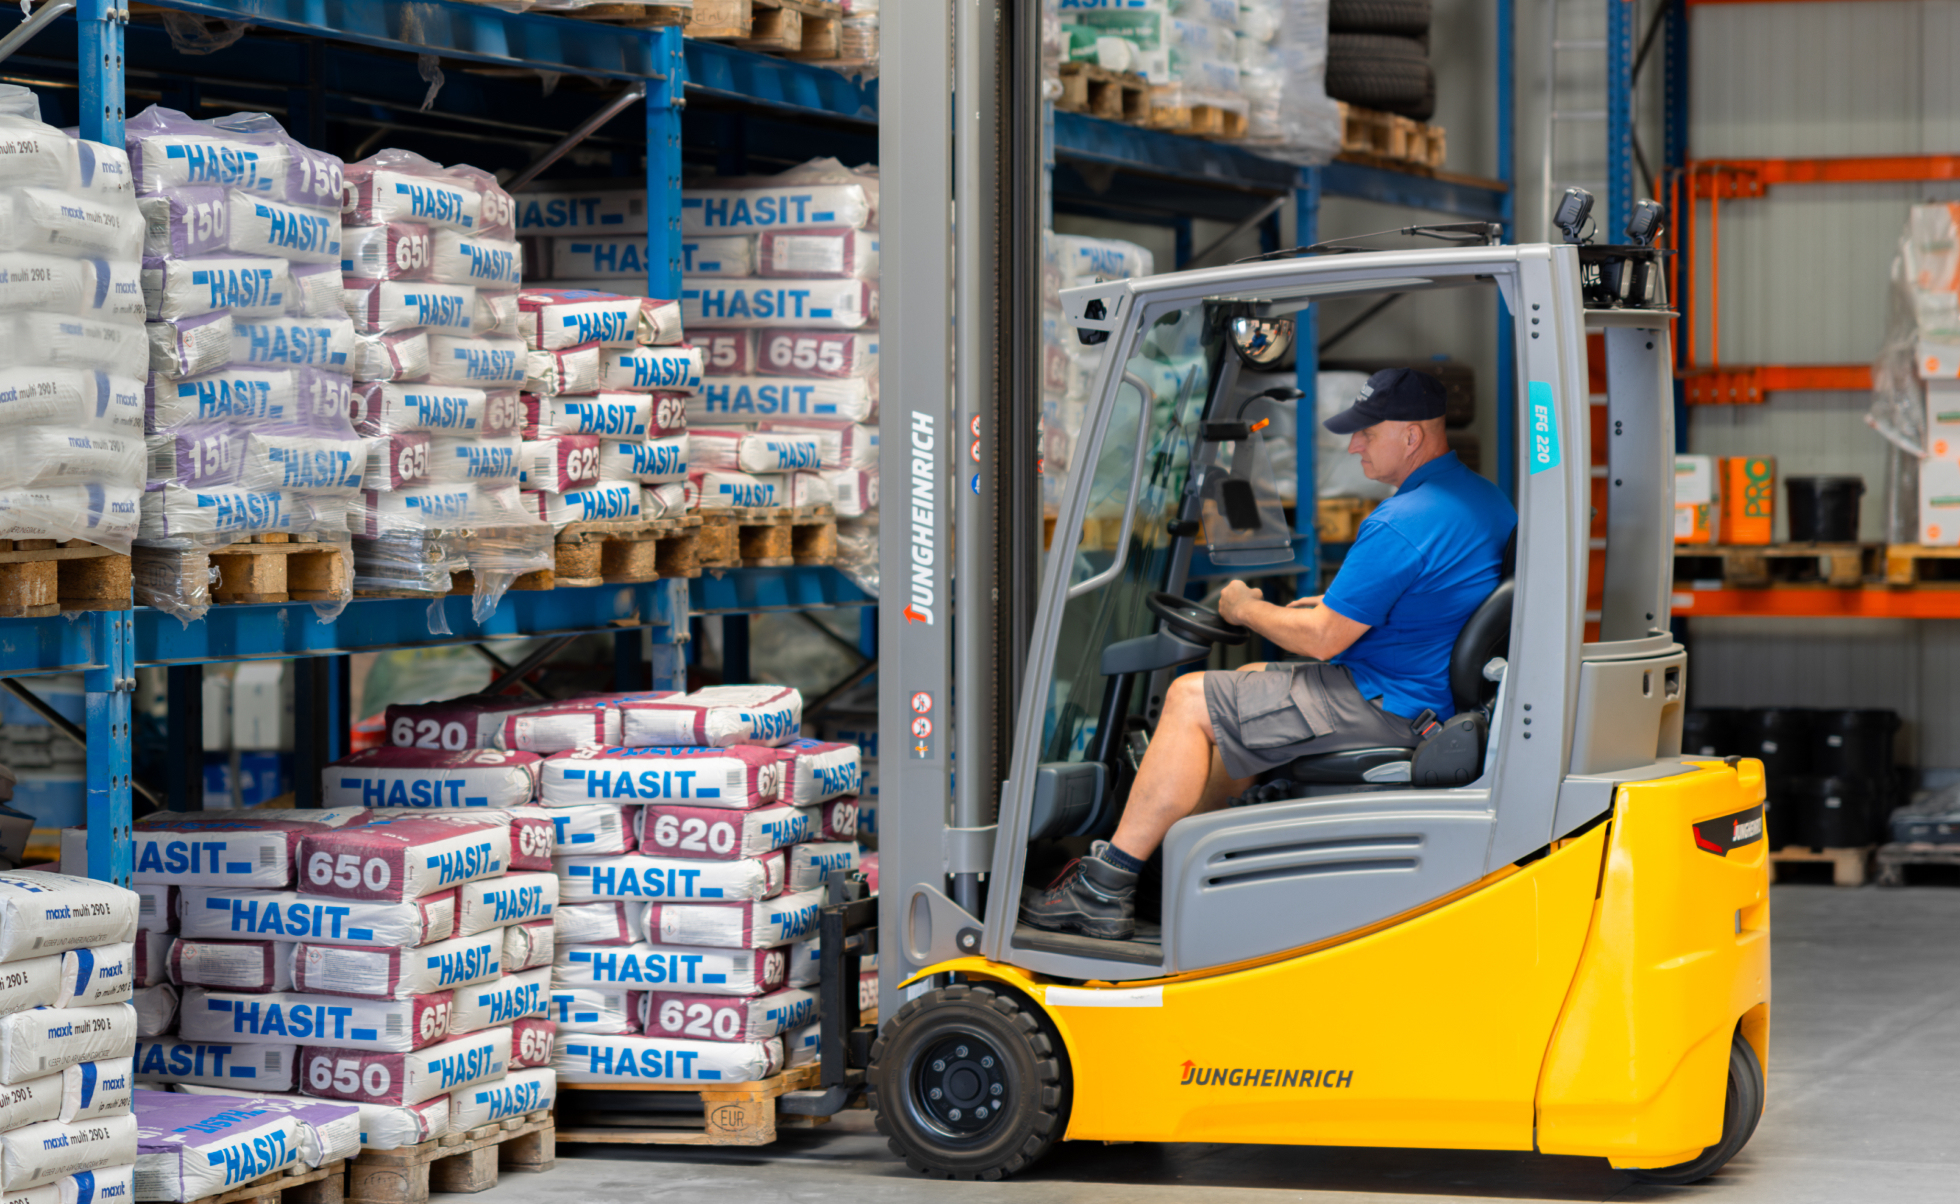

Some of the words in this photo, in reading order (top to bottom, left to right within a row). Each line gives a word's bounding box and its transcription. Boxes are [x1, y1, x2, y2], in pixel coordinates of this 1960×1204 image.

[17, 141, 34, 154] 290
[34, 141, 40, 153] E
[184, 145, 259, 188] HASIT
[299, 156, 343, 200] 150
[61, 205, 85, 221] maxit
[86, 211, 103, 224] multi
[409, 184, 464, 224] HASIT
[704, 194, 812, 227] HASIT
[181, 200, 225, 246] 150
[268, 207, 331, 253] HASIT
[395, 234, 430, 271] 650
[469, 245, 514, 281] HASIT
[10, 269, 29, 283] multi
[31, 268, 46, 283] 290
[115, 280, 137, 294] maxit
[209, 269, 273, 309] HASIT
[417, 294, 464, 328] HASIT
[702, 289, 811, 319] HASIT
[249, 324, 331, 364] HASIT
[577, 311, 628, 344] HASIT
[466, 348, 516, 381] HASIT
[633, 356, 691, 388] HASIT
[769, 337, 845, 373] 655
[0, 386, 18, 403] axit
[19, 383, 38, 399] multi
[38, 382, 51, 397] 290
[116, 393, 138, 408] maxit
[196, 379, 271, 419] HASIT
[309, 377, 351, 419] 150
[705, 385, 815, 415] HASIT
[417, 395, 469, 429] HASIT
[579, 403, 637, 435] HASIT
[1535, 404, 1549, 432] EFG
[68, 436, 92, 450] maxit
[188, 433, 231, 480] 150
[632, 444, 680, 475] HASIT
[777, 442, 816, 470] HASIT
[1536, 434, 1550, 464] 220
[282, 449, 352, 488] HASIT
[466, 446, 513, 478] HASIT
[580, 487, 631, 521] HASIT
[732, 484, 775, 508] HASIT
[1744, 459, 1772, 517] PRO
[112, 500, 135, 513] maxit
[215, 491, 283, 531] HASIT
[911, 411, 935, 625] JUNGHEINRICH
[391, 716, 468, 751] 620
[749, 708, 793, 741] HASIT
[362, 778, 466, 808] HASIT
[587, 769, 697, 798] HASIT
[757, 764, 778, 798] 62
[821, 762, 857, 796] HASIT
[653, 814, 737, 855] 620
[771, 814, 809, 850] HASIT
[307, 851, 391, 892] 650
[438, 843, 492, 886] HASIT
[592, 866, 701, 898] HASIT
[46, 905, 71, 920] maxit
[72, 904, 91, 918] multi
[90, 903, 106, 916] 290
[106, 903, 111, 915] E
[231, 898, 351, 938] HASIT
[493, 885, 543, 922] HASIT
[780, 903, 818, 941] HASIT
[6, 973, 22, 988] 290
[22, 971, 28, 984] E
[99, 960, 123, 979] maxit
[439, 944, 492, 986] HASIT
[592, 951, 703, 984] HASIT
[763, 951, 784, 984] 62
[234, 1000, 353, 1039] HASIT
[488, 982, 541, 1024] HASIT
[659, 999, 741, 1040] 620
[775, 998, 814, 1036] HASIT
[48, 1022, 73, 1039] maxit
[74, 1019, 91, 1034] multi
[92, 1018, 108, 1032] 290
[519, 1027, 554, 1065] 650
[590, 1045, 698, 1080] HASIT
[102, 1074, 125, 1091] maxit
[309, 1056, 391, 1097] 650
[439, 1044, 494, 1089] HASIT
[1180, 1067, 1354, 1088] JUNGHEINRICH
[0, 1093, 10, 1108] ulti
[11, 1088, 26, 1104] 290
[487, 1080, 542, 1121] HASIT
[720, 1110, 745, 1127] EUR
[43, 1133, 69, 1150] maxit
[70, 1130, 89, 1145] multi
[89, 1128, 104, 1141] 290
[222, 1129, 286, 1186] HASIT
[101, 1181, 125, 1199] maxit
